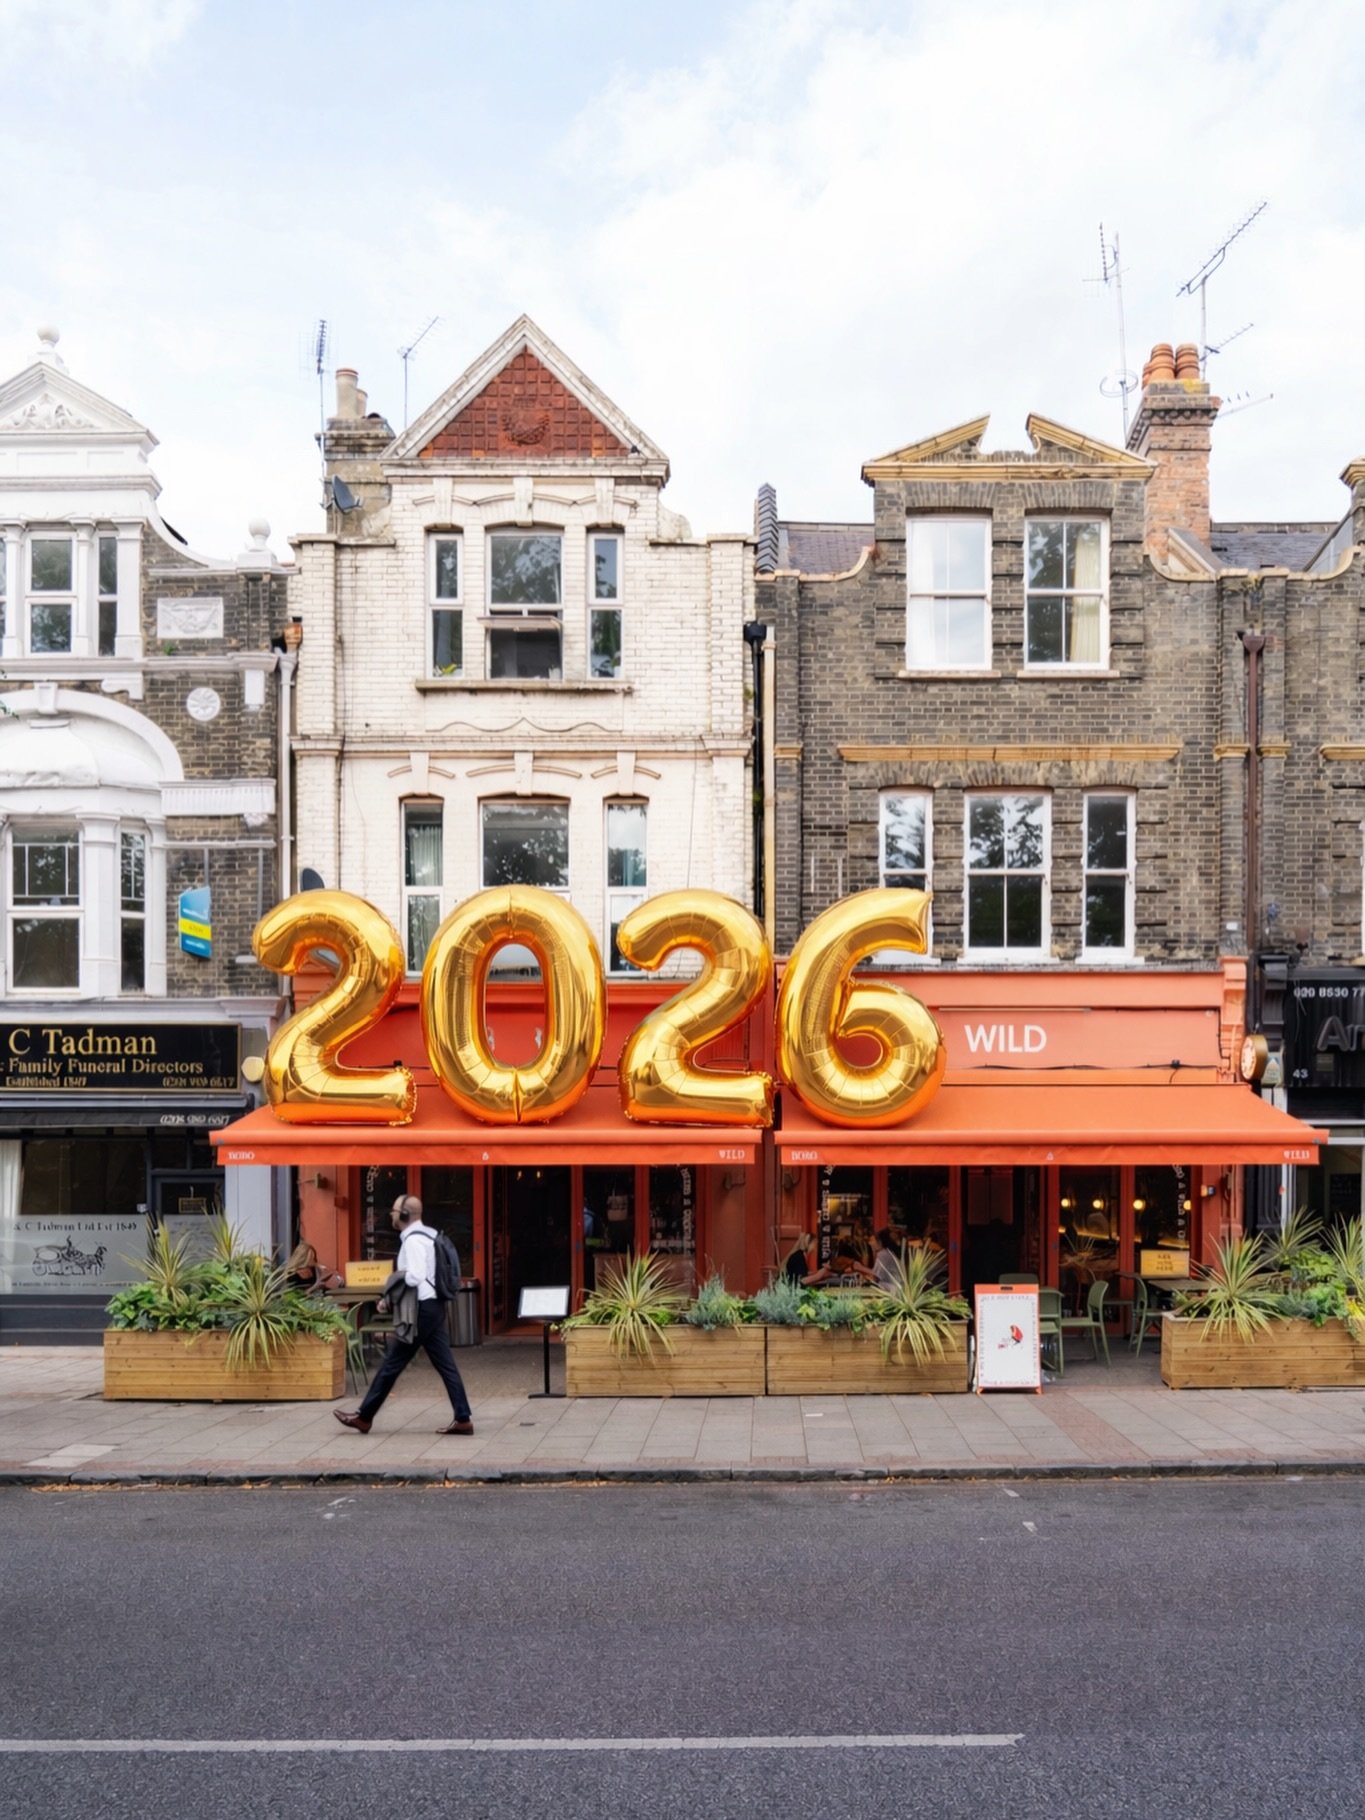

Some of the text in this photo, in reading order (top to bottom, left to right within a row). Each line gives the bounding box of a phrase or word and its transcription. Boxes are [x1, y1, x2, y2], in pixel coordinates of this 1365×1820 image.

[252, 884, 947, 1128] 2026
[8, 1028, 157, 1055] C Tadman
[963, 1024, 1047, 1053] WILD
[9, 1057, 204, 1076] Family Funeral Directors
[1292, 1069, 1309, 1079] 43
